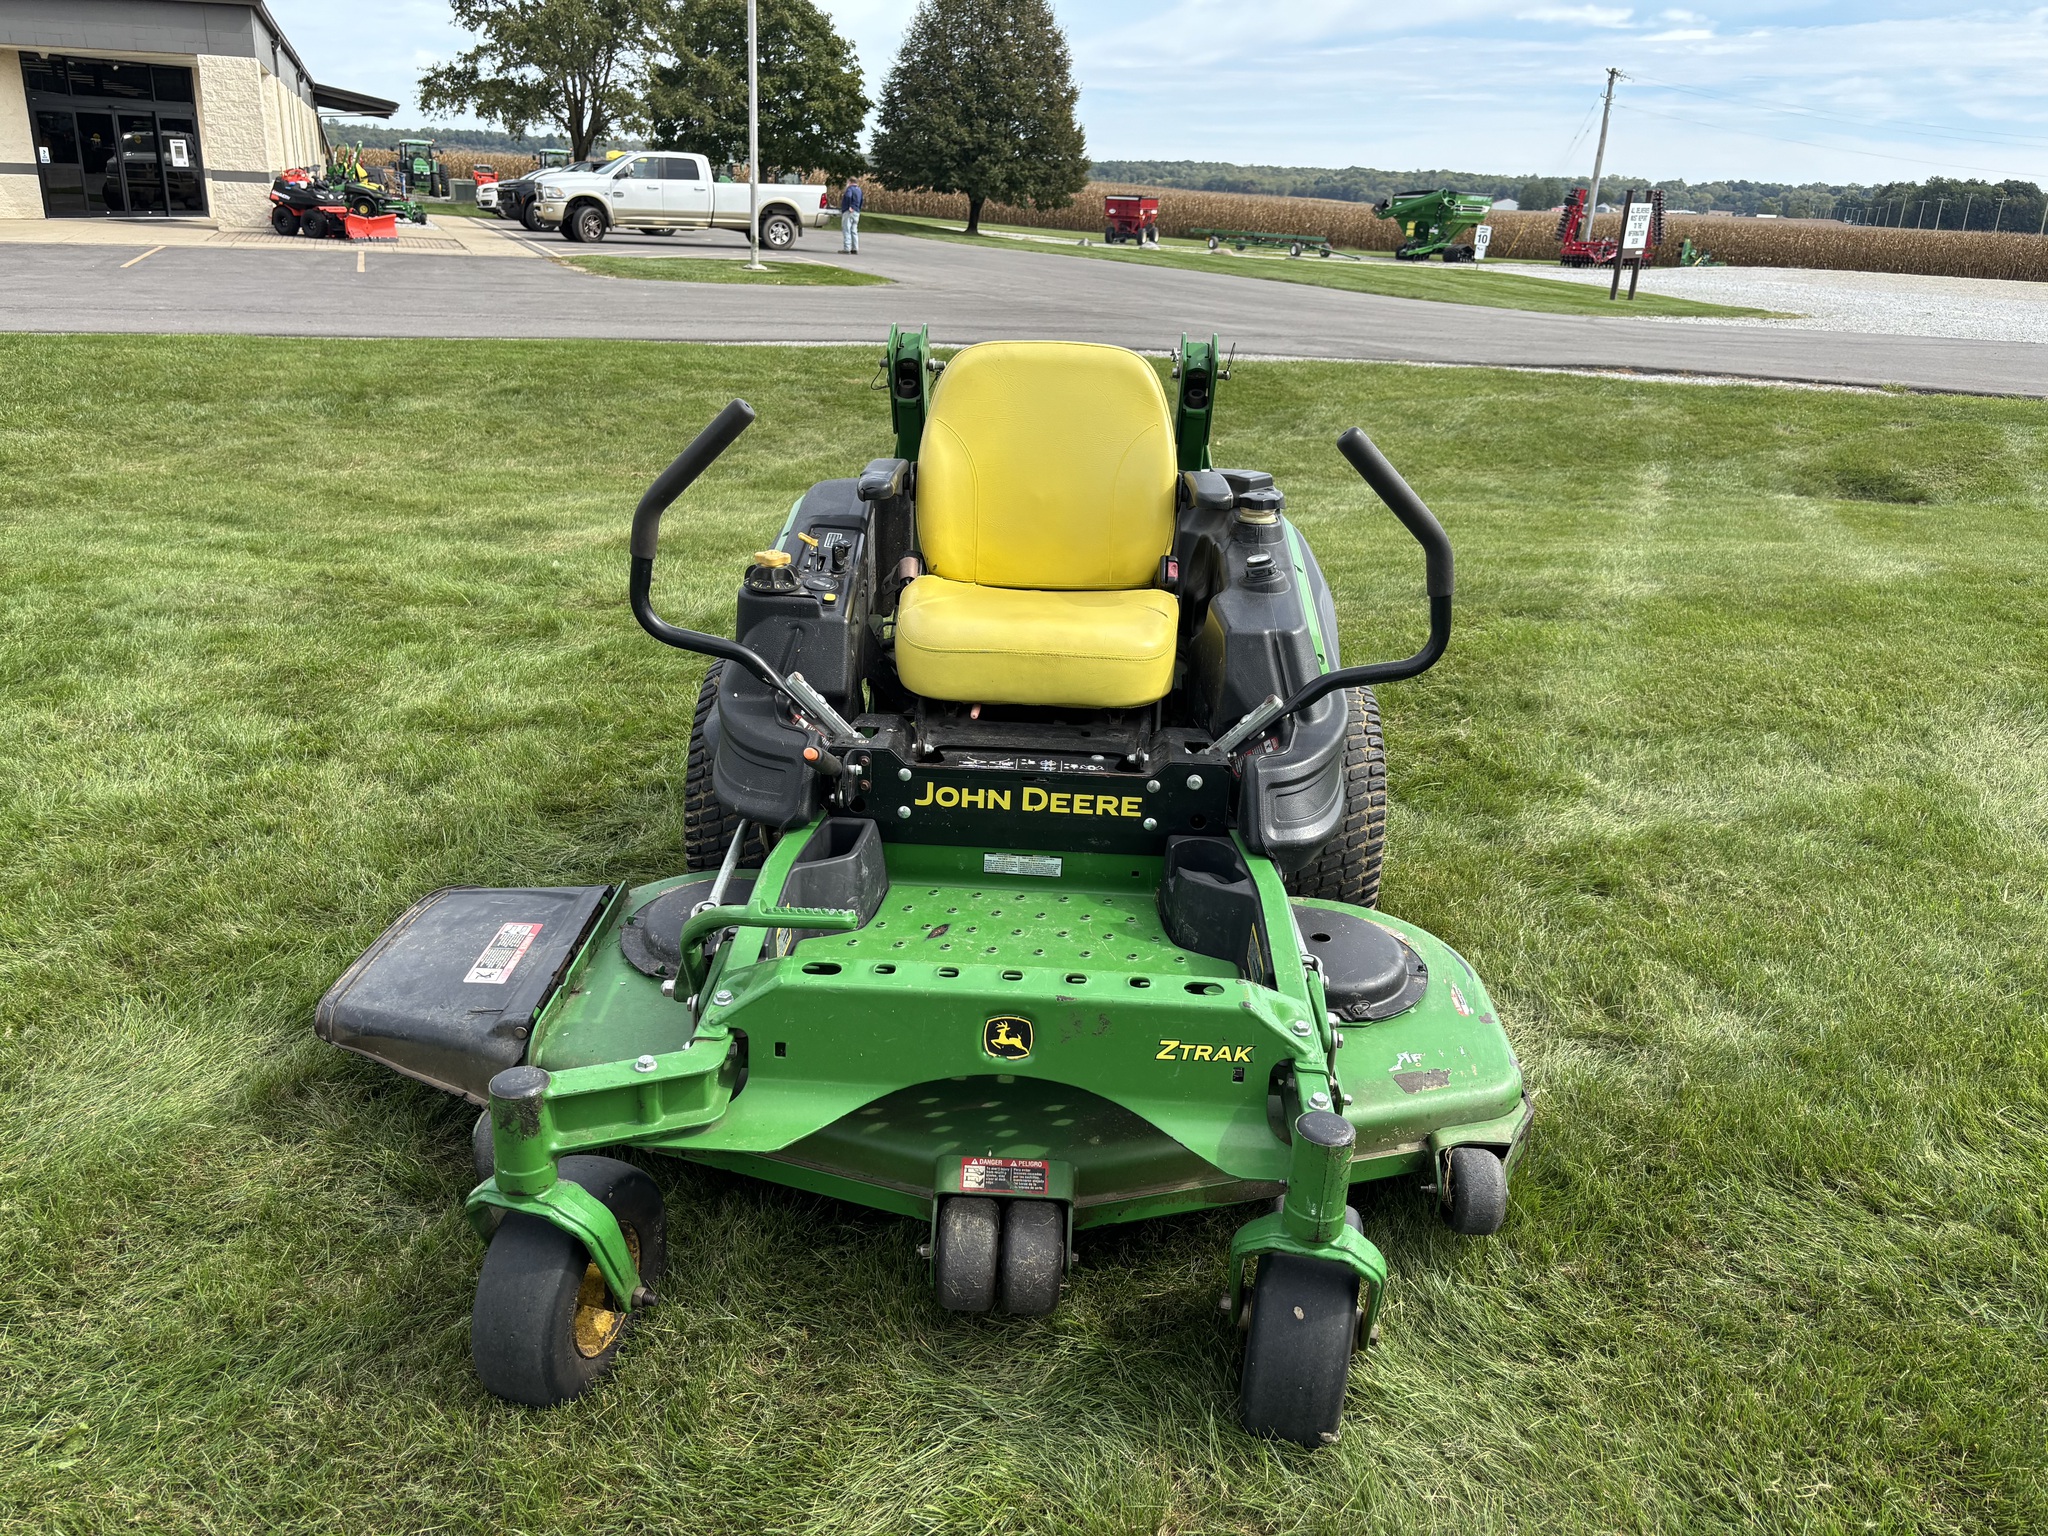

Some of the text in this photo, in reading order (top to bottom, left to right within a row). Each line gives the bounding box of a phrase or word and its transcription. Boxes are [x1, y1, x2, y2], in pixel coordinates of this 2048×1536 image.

[1477, 234, 1488, 244] 10
[914, 781, 1143, 818] JOHN DEERE
[1155, 1039, 1254, 1063] ZTRAK
[979, 1158, 1003, 1166] DANGER
[1018, 1160, 1043, 1168] PELIGRO
